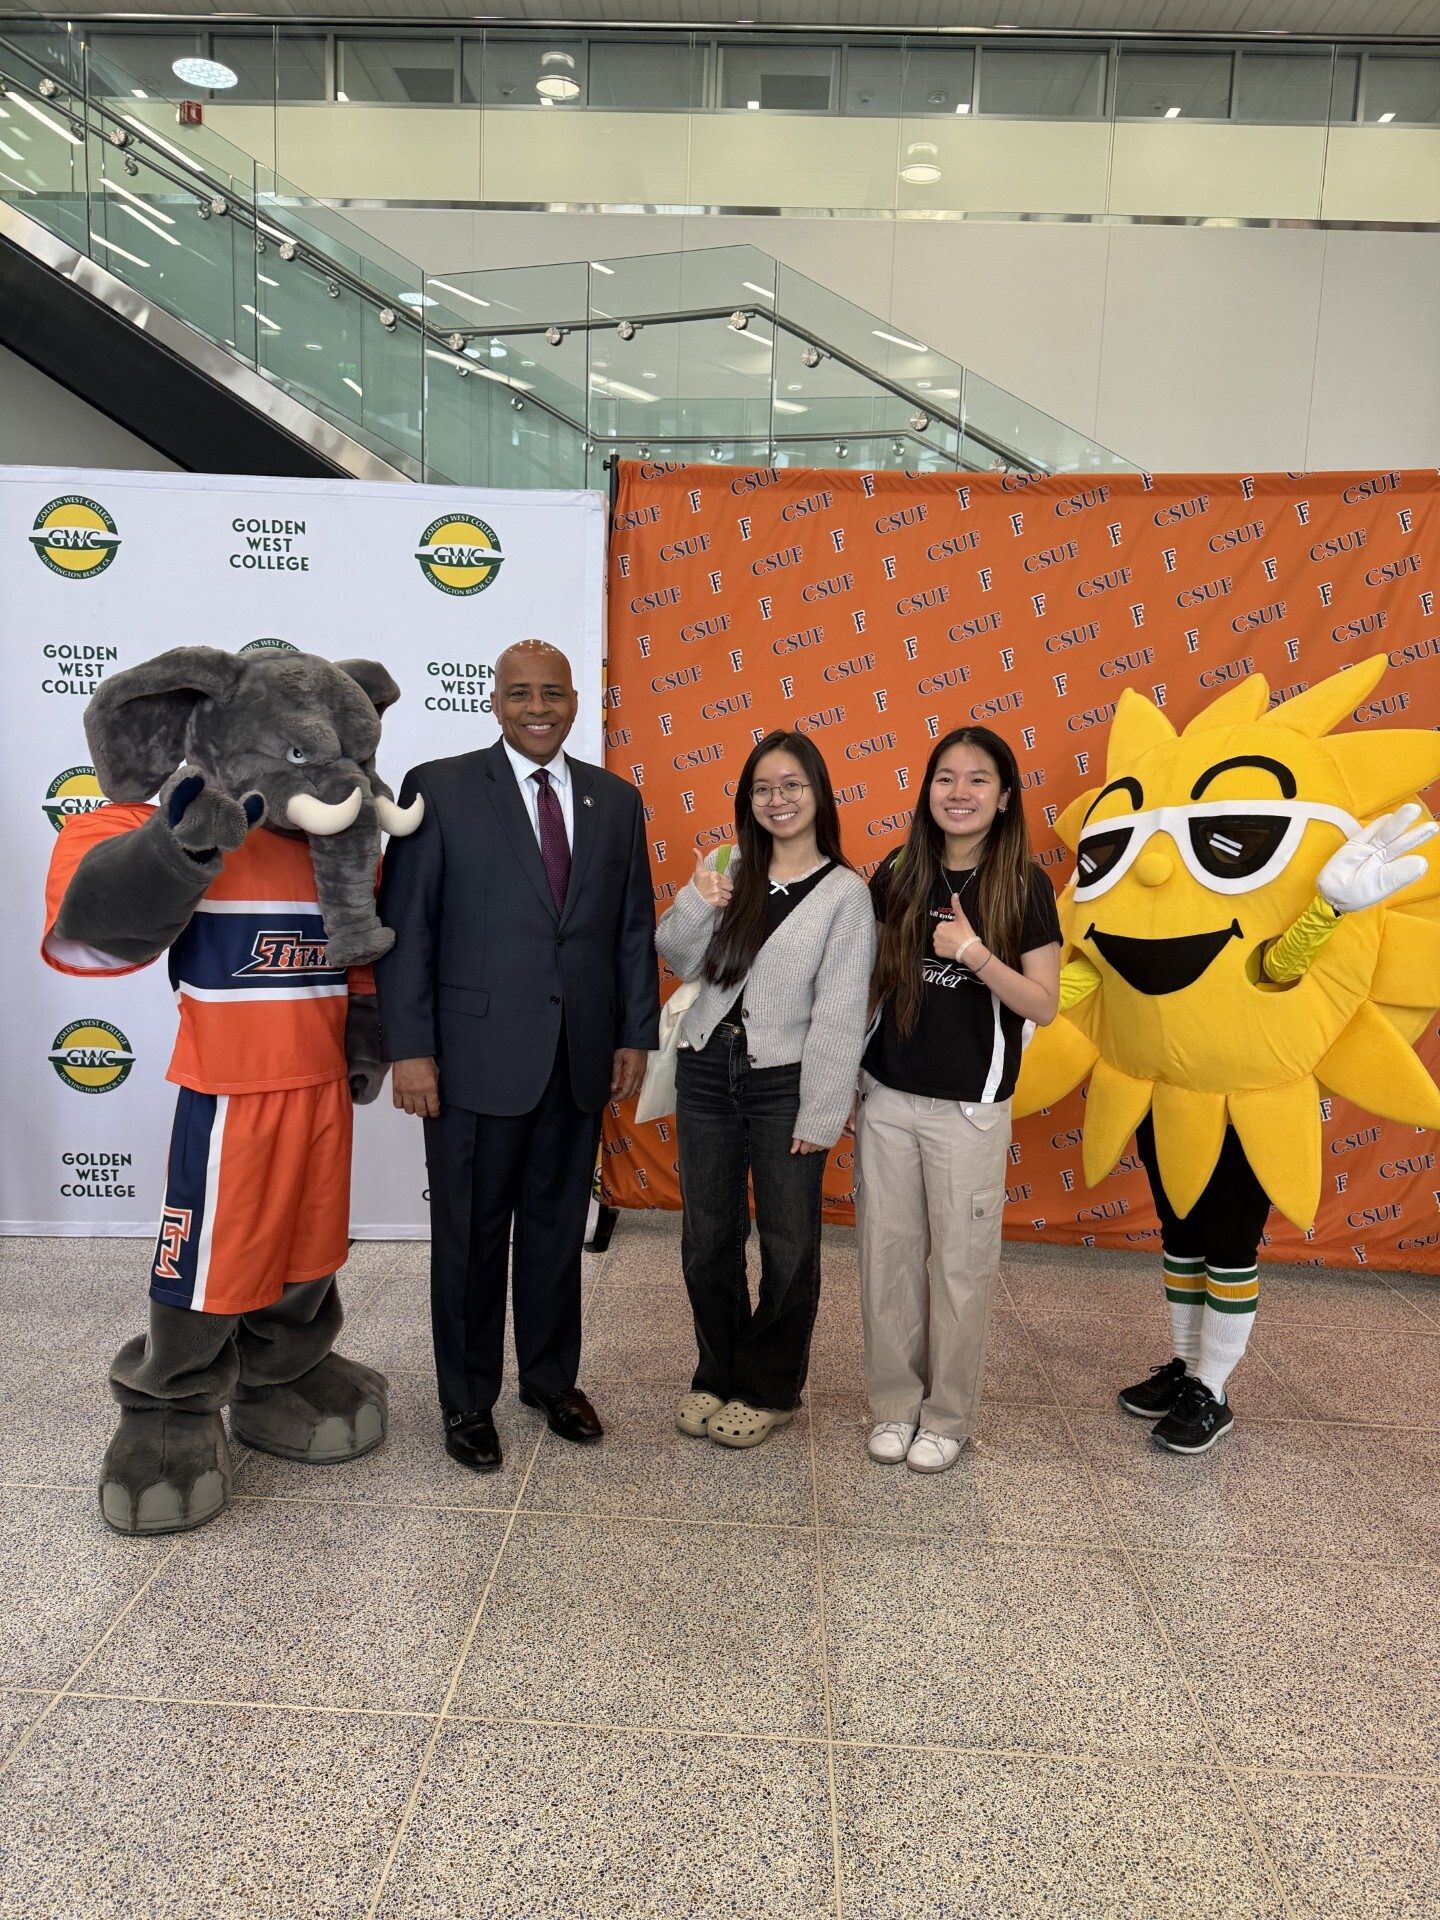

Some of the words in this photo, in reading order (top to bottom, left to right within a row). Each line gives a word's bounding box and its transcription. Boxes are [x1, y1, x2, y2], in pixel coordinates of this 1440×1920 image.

[731, 467, 782, 496] CSUF
[862, 474, 876, 499] F
[1240, 476, 1255, 501] F
[1342, 472, 1402, 505] CSUF
[688, 489, 701, 513] F
[781, 490, 832, 522] CSUF
[956, 486, 970, 511] F
[1054, 485, 1109, 518] CSUF
[37, 499, 63, 523] GOLDEN
[64, 496, 84, 504] WEST
[85, 499, 113, 526] COLLEGE
[614, 504, 661, 531] CSUF
[874, 504, 927, 534] CSUF
[1153, 495, 1209, 527] CSUF
[1294, 501, 1310, 525] F
[1396, 509, 1413, 534] F
[232, 518, 305, 534] GOLDEN
[423, 516, 449, 541] GOLDEN
[471, 517, 498, 543] COLLEGE
[737, 517, 751, 541] F
[1009, 512, 1024, 537] F
[1107, 522, 1122, 547] F
[1208, 520, 1264, 553] CSUF
[48, 529, 101, 548] GWC
[246, 537, 292, 552] WEST
[659, 533, 710, 562] CSUF
[830, 528, 844, 553] F
[926, 530, 980, 561] CSUF
[1309, 528, 1366, 562] CSUF
[41, 554, 81, 578] HUNTINGTON
[102, 559, 111, 567] CA
[230, 554, 308, 571] COLLEGE
[433, 546, 485, 566] GWC
[618, 554, 630, 577] F
[751, 545, 803, 576] CSUF
[882, 556, 896, 580] F
[1023, 540, 1078, 573] CSUF
[1161, 548, 1176, 572] F
[977, 567, 992, 592] F
[1261, 557, 1277, 582] F
[1364, 554, 1421, 587] CSUF
[426, 571, 465, 595] HUNTINGTON
[485, 576, 494, 584] CA
[708, 570, 721, 594] F
[801, 573, 853, 602] CSUF
[1076, 567, 1131, 598] CSUF
[1176, 576, 1232, 608] CSUF
[628, 586, 681, 615] CSUF
[896, 585, 949, 616] CSUF
[1031, 593, 1045, 617] F
[1317, 582, 1332, 607] F
[1419, 591, 1433, 616] F
[758, 596, 772, 620] F
[1130, 603, 1144, 628] F
[1231, 601, 1286, 633] CSUF
[679, 614, 730, 643] CSUF
[852, 609, 865, 634] F
[947, 612, 1002, 642] CSUF
[1331, 611, 1386, 643] CSUF
[260, 639, 280, 647] WEST
[637, 635, 650, 658] F
[771, 626, 823, 656] CSUF
[903, 636, 917, 660] F
[1044, 622, 1099, 653] CSUF
[1184, 628, 1199, 653] F
[43, 644, 118, 660] GOLDEN
[729, 649, 742, 672] F
[999, 647, 1014, 672] F
[1285, 638, 1300, 662] F
[58, 662, 104, 677] WEST
[822, 653, 875, 683] CSUF
[1098, 647, 1154, 678] CSUF
[1199, 657, 1254, 688] CSUF
[42, 679, 97, 695] COLLE
[440, 680, 486, 695] WEST
[650, 665, 701, 693] CSUF
[780, 676, 793, 699] F
[917, 666, 970, 695] CSUF
[1052, 673, 1067, 697] F
[425, 696, 493, 713] COLLEG
[606, 685, 621, 708] F
[700, 692, 751, 720] CSUF
[873, 689, 887, 713] F
[969, 691, 1023, 721] CSUF
[1152, 684, 1167, 707] F
[1269, 682, 1308, 709] SUF
[1352, 692, 1410, 723] CSUF
[658, 713, 672, 736] F
[794, 706, 847, 735] CSUF
[925, 715, 939, 738] F
[606, 728, 631, 748] UF
[844, 732, 896, 760] CSUF
[1021, 726, 1035, 750] F
[672, 743, 723, 771] CSUF
[1074, 752, 1089, 775] F
[50, 769, 75, 793] GOLDEN
[75, 767, 96, 775] WEST
[630, 764, 645, 787] F
[895, 767, 909, 790] F
[1019, 768, 1045, 790] UF
[681, 791, 694, 813] F
[833, 782, 868, 807] SUF
[1043, 804, 1057, 827] F
[695, 823, 735, 847] CSU
[653, 840, 666, 863] F
[653, 881, 677, 901] UF
[56, 1022, 80, 1044] GOLDEN
[101, 1022, 128, 1045] COLLEGE
[66, 1049, 116, 1066] GWC
[60, 1071, 98, 1093] HUNTINGTON
[117, 1074, 126, 1082] CA
[1320, 1099, 1332, 1121] F
[656, 1122, 670, 1143] F
[1330, 1127, 1380, 1155] CSUF
[602, 1135, 632, 1159] SUF
[1008, 1142, 1022, 1165] F
[62, 1153, 131, 1166] GOLDEN
[1378, 1154, 1435, 1179] CSUF
[76, 1169, 119, 1181] WEST
[635, 1167, 648, 1189] F
[1060, 1169, 1073, 1191] F
[1335, 1173, 1348, 1193] F
[60, 1184, 135, 1197] COLLEGE
[1003, 1183, 1032, 1205] UF
[1347, 1204, 1401, 1228] CSUF
[1397, 1235, 1440, 1248] CSU
[1351, 1245, 1367, 1264] F
